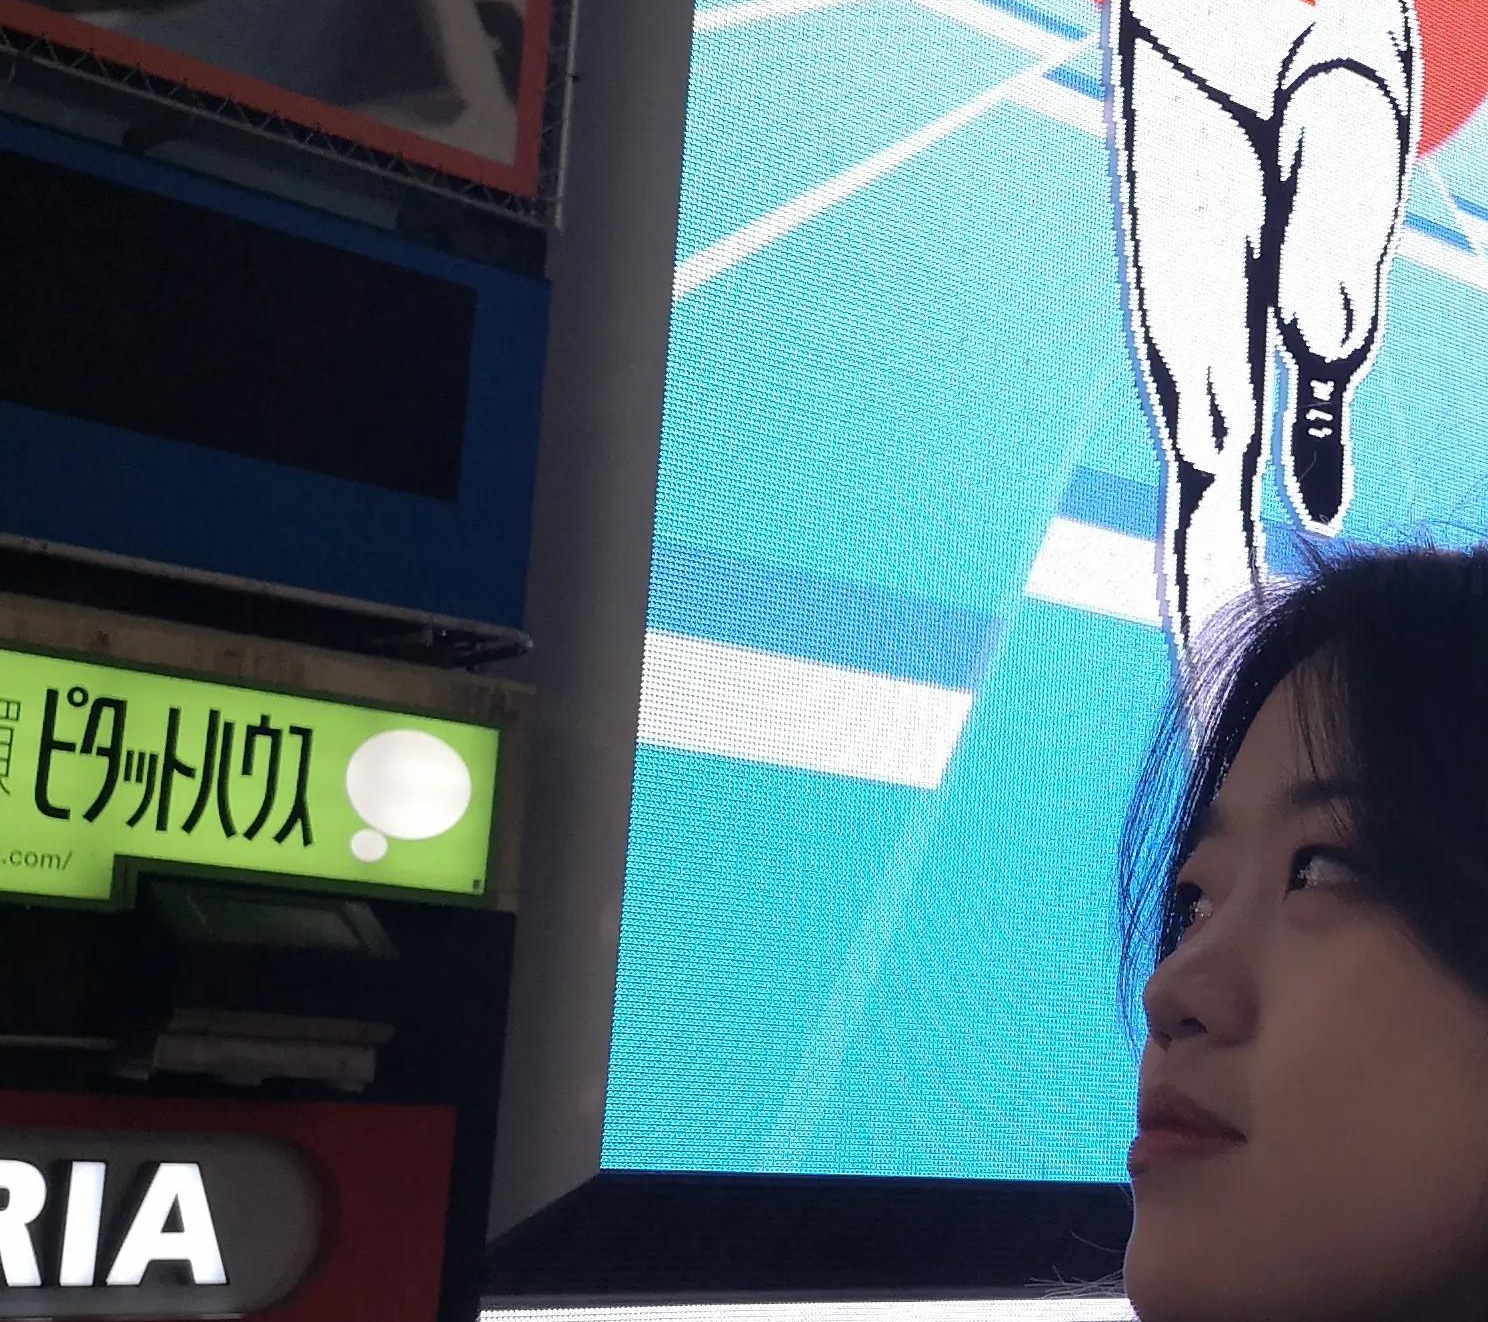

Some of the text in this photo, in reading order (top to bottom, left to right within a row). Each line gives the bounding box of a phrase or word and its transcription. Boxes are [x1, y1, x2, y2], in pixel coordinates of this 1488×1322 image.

[34, 685, 314, 848] ピタットハウス
